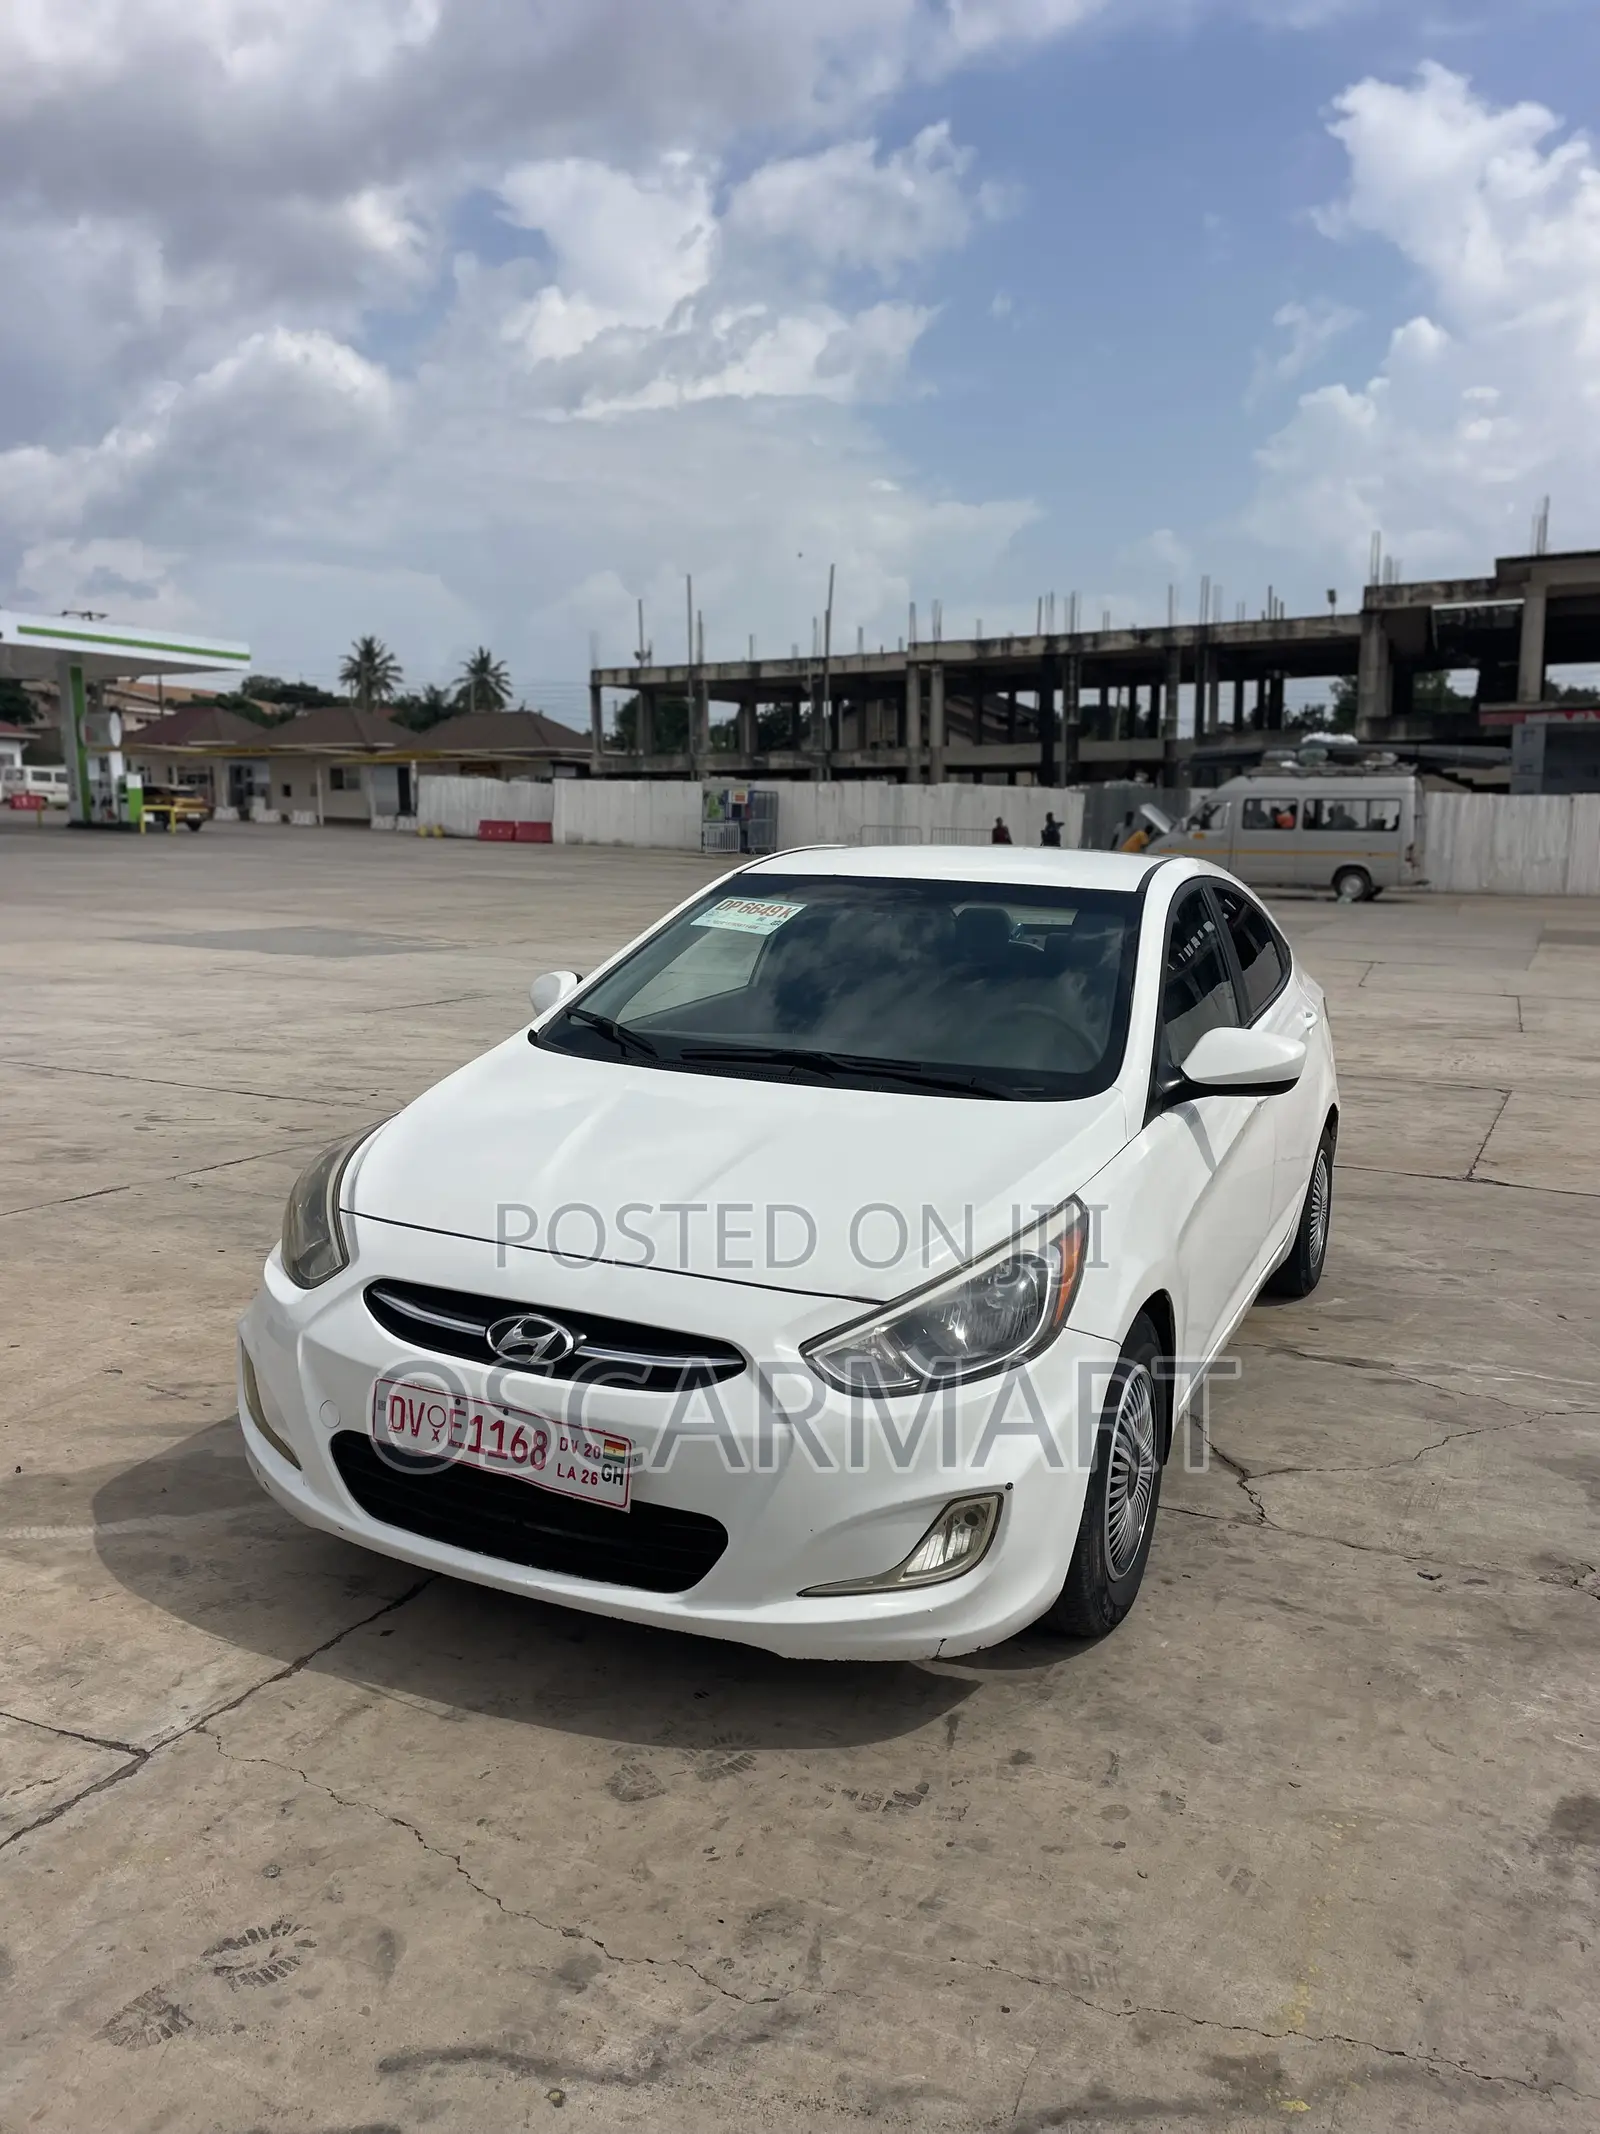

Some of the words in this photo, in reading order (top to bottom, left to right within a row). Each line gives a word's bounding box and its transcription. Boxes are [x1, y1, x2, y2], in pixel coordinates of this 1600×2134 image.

[715, 900, 741, 911] DP
[389, 1394, 425, 1438] DV
[448, 1408, 548, 1471] E1168
[559, 1436, 579, 1454] DV
[583, 1443, 601, 1459] 20
[556, 1463, 577, 1481] LA
[580, 1469, 599, 1486] 26
[601, 1463, 625, 1486] GH
